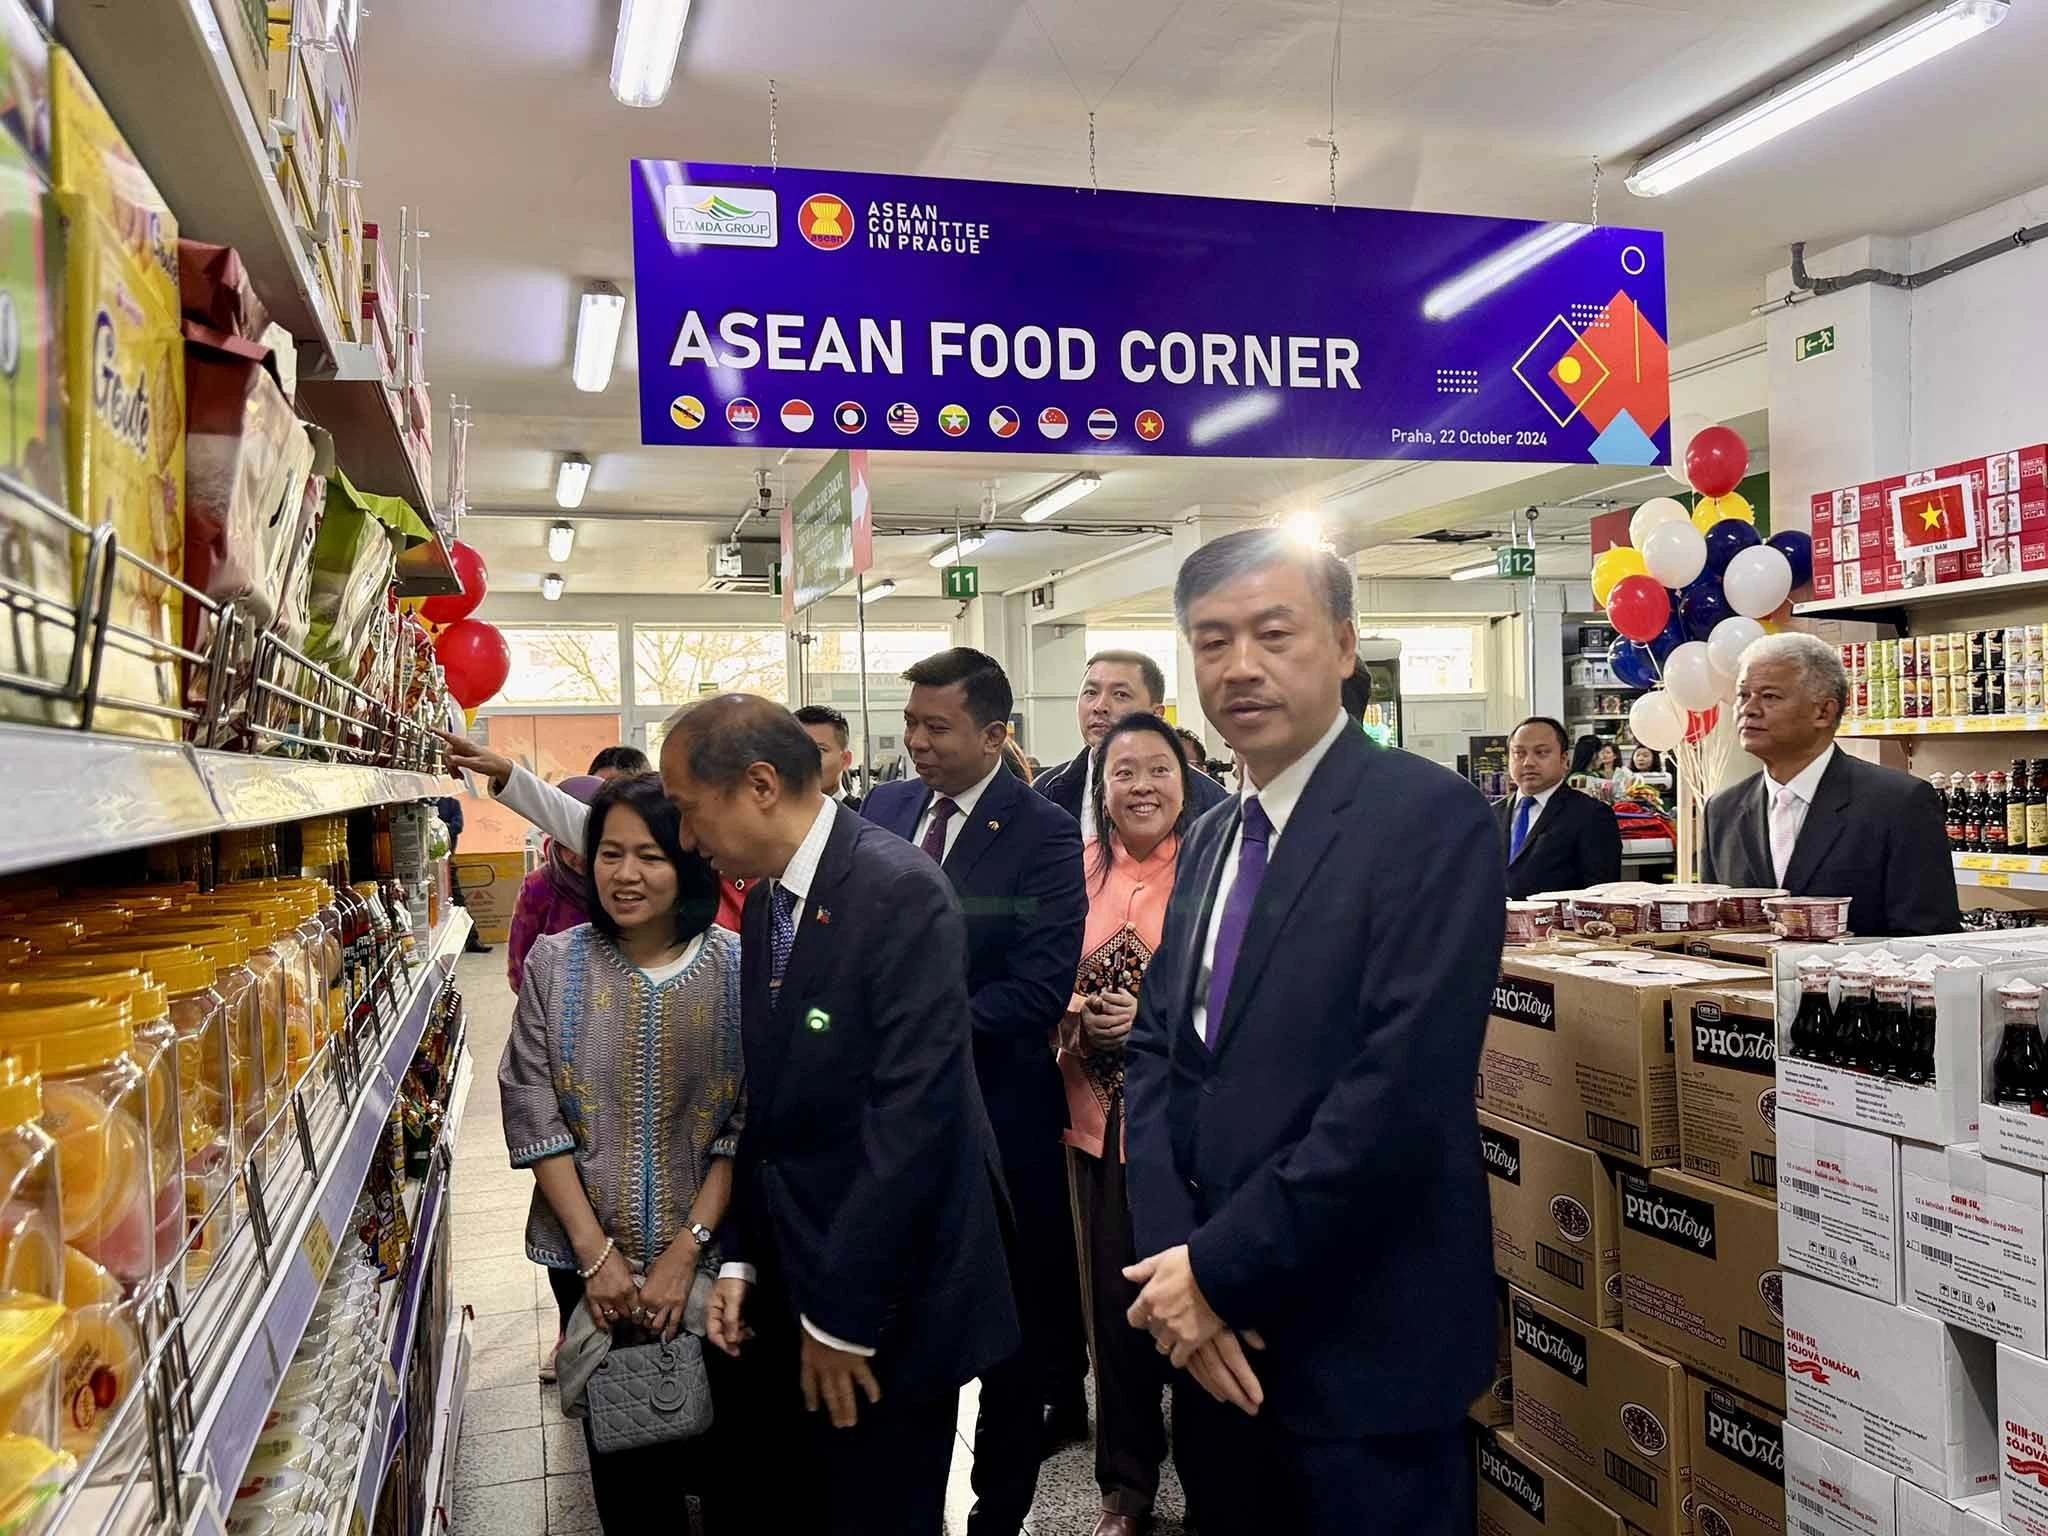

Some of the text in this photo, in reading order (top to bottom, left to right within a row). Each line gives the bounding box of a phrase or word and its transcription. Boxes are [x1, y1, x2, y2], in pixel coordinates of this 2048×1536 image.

[868, 201, 938, 220] ASEAN
[676, 219, 768, 236] TAMDA GROUP
[868, 217, 990, 239] COMMITTEE
[809, 233, 845, 244] asean
[868, 233, 981, 254] IN PRAGUE
[669, 310, 1361, 391] ASEAN FOOD CORNER
[1391, 428, 1548, 446] Praha, 22 October 2024
[1498, 554, 1511, 575] 12
[1512, 552, 1534, 572] 12
[950, 566, 976, 594] 11
[1786, 1328, 1816, 1348] CHIN-SU
[2005, 1420, 2044, 1447] CHIN-SU
